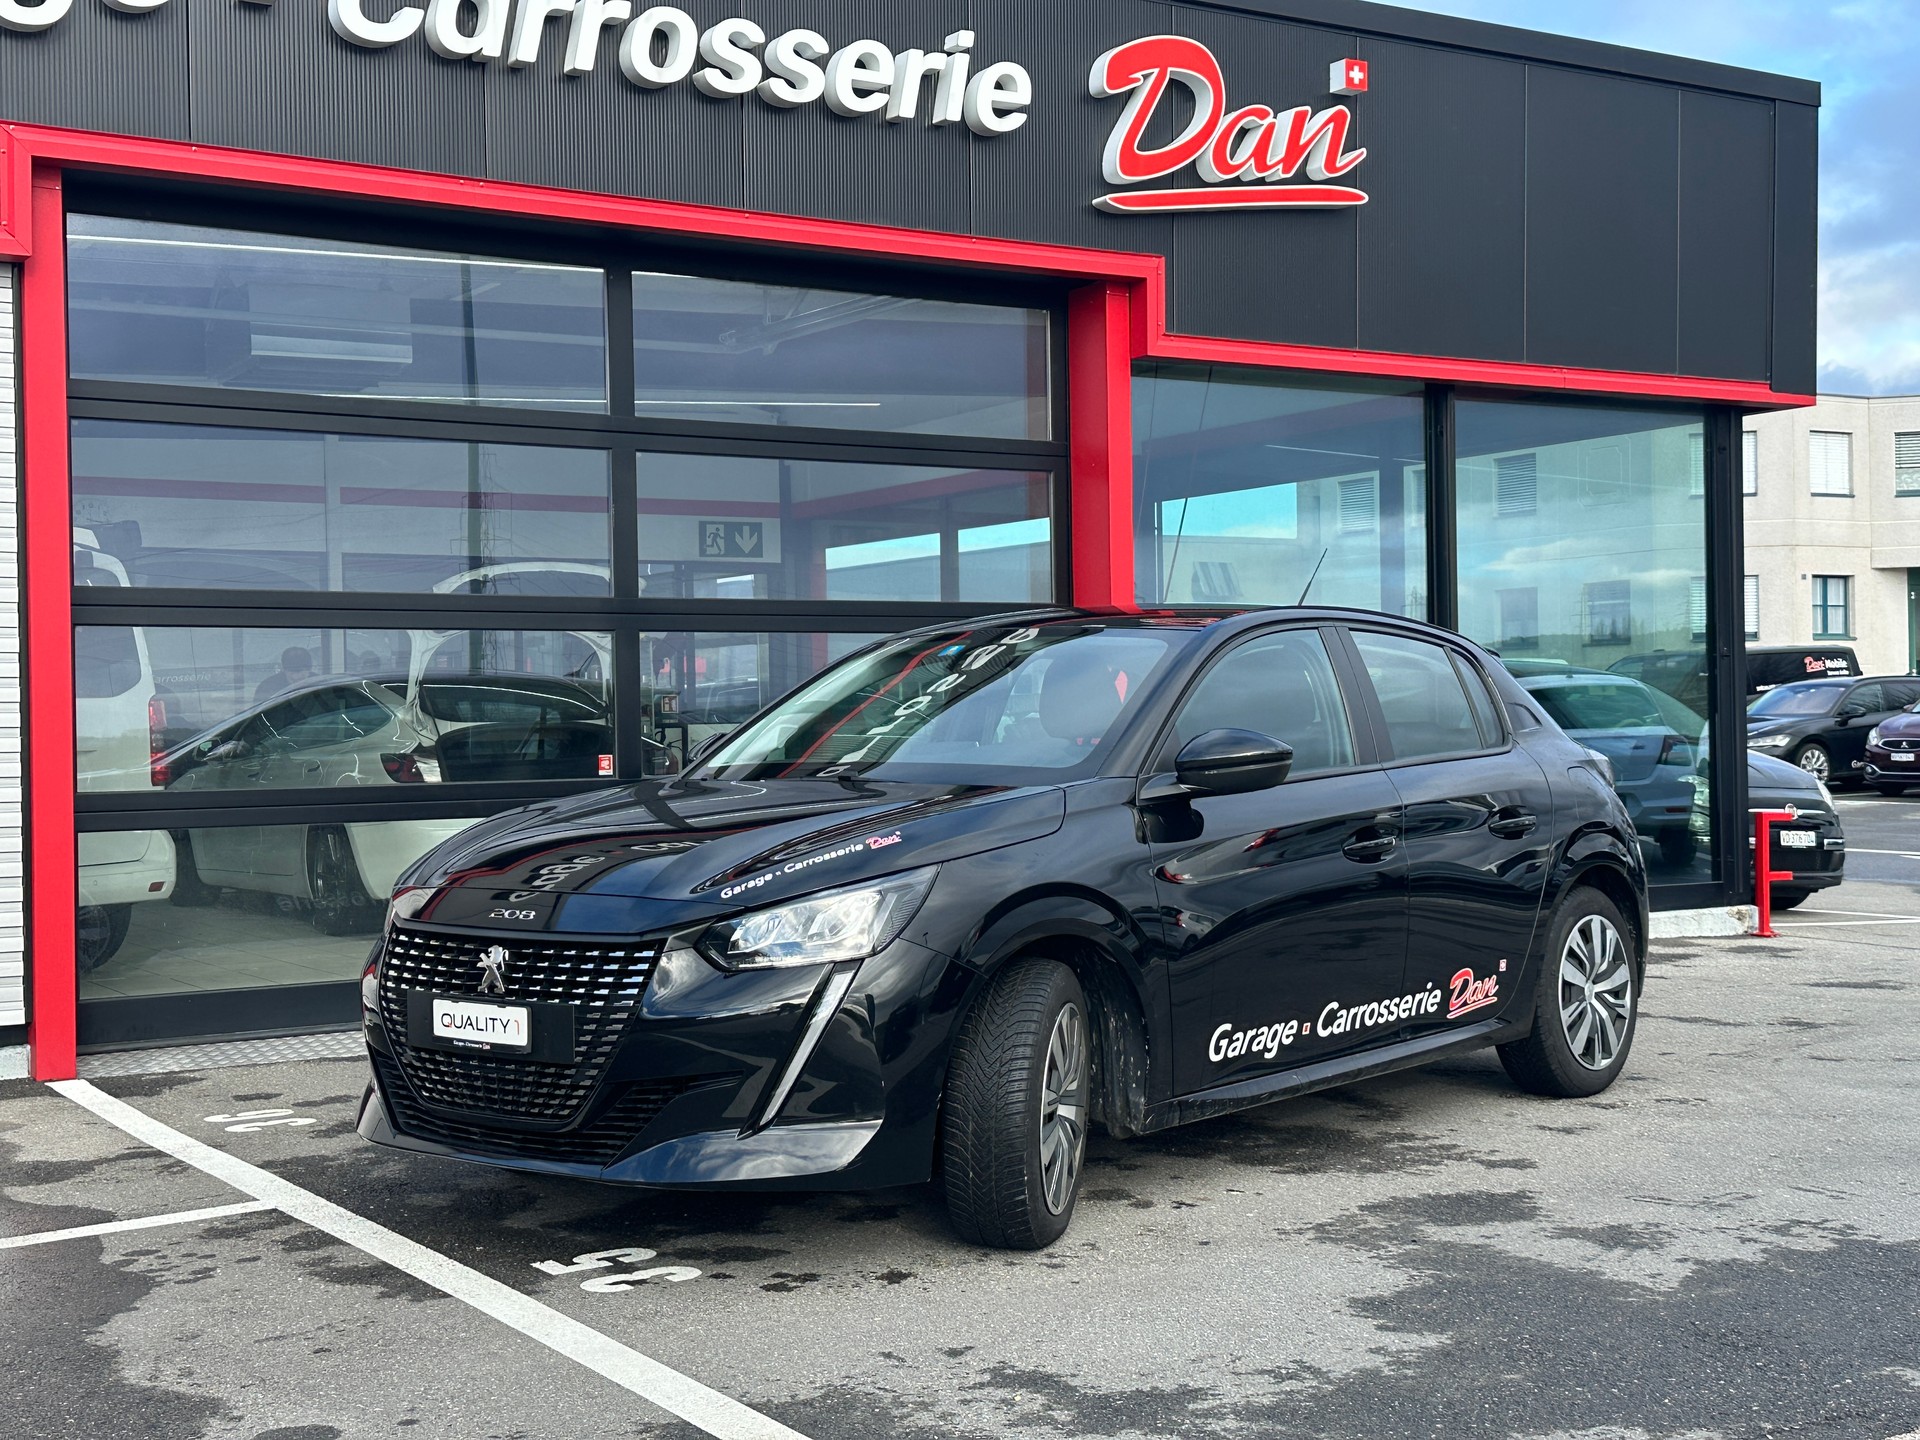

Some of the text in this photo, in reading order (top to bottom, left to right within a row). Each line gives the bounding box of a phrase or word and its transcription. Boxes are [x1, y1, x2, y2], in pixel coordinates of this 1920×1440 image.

[1090, 35, 1367, 186] Dan
[720, 873, 774, 899] Garage
[784, 843, 864, 873] Carrosserie
[488, 908, 537, 920] 208
[441, 1013, 510, 1034] QUALITY
[1208, 967, 1498, 1062] Garage Carrosserie Dan
[529, 1247, 703, 1293] 35
